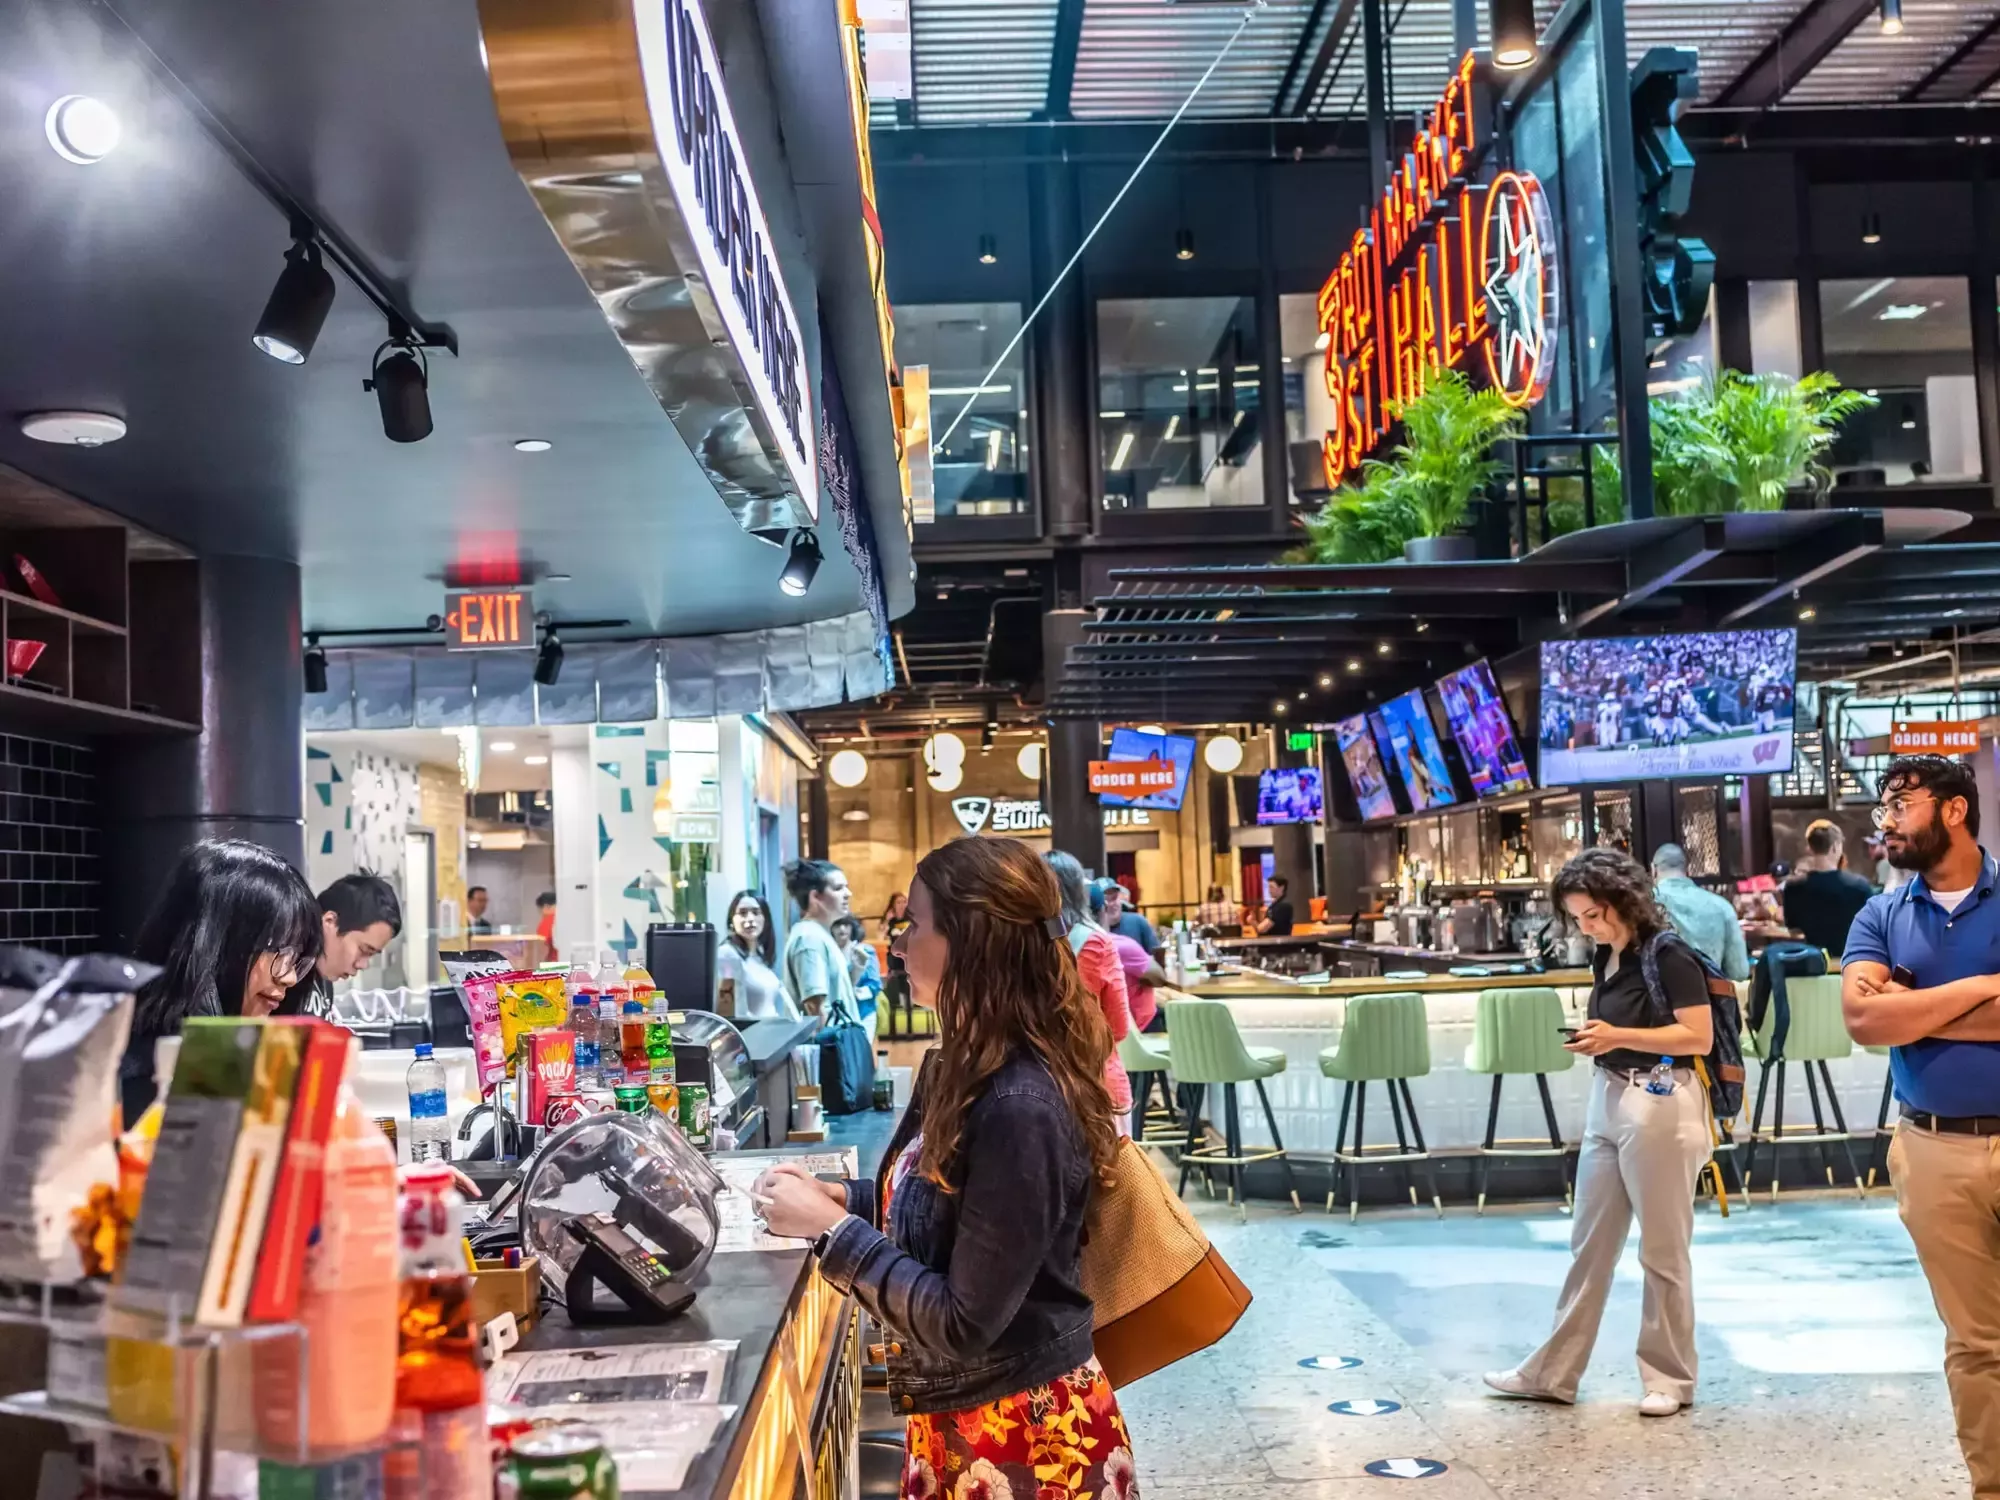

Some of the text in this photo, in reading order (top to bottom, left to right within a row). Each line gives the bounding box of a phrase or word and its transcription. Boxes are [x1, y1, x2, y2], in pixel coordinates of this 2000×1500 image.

[1383, 47, 1476, 266] MARKET
[1389, 185, 1489, 420] HALL
[460, 592, 522, 644] EXIT
[1894, 731, 1977, 747] ORDER HERE
[1092, 771, 1173, 787] ORDER HERE
[992, 807, 1150, 831] SWIN ITE
